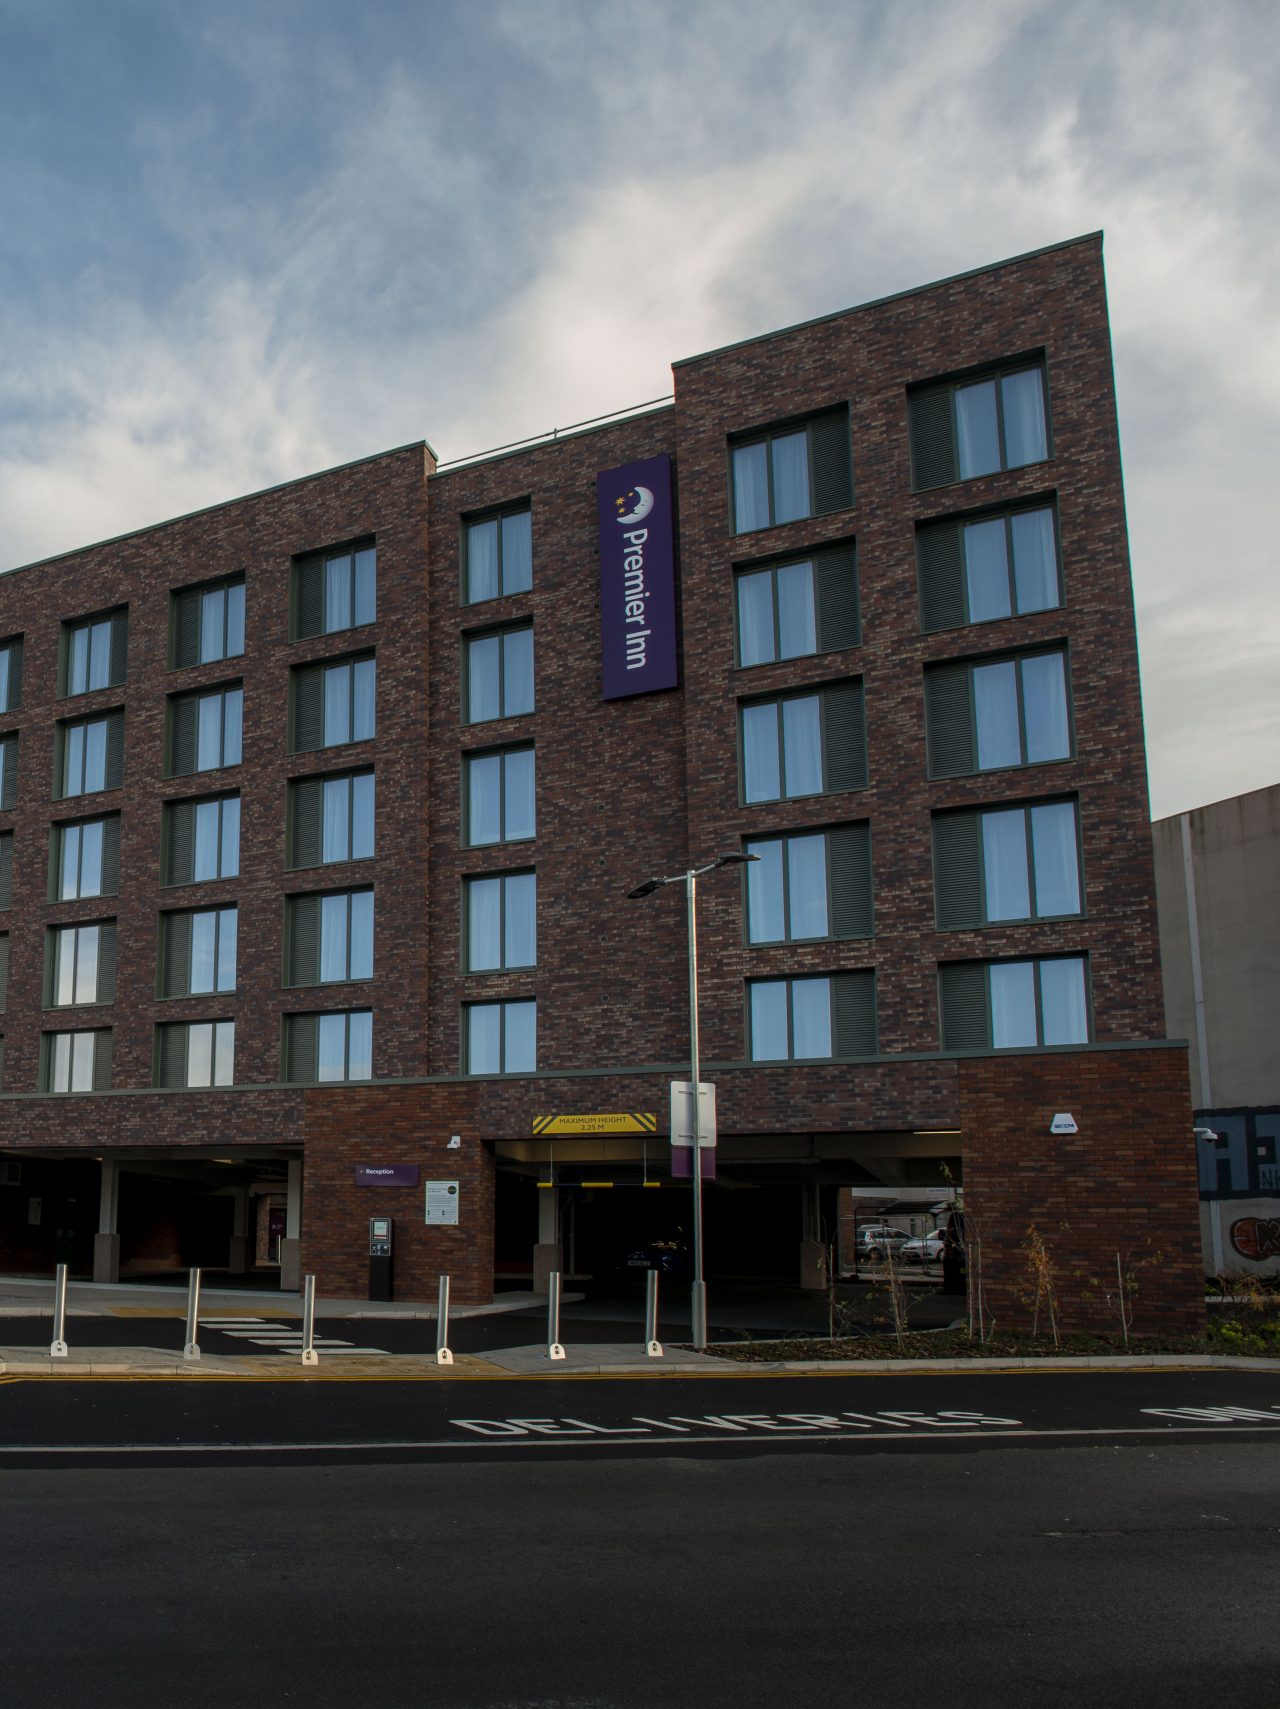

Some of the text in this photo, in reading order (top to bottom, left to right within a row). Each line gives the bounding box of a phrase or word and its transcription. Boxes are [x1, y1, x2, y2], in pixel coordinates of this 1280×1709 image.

[623, 528, 652, 670] Premier Inn
[559, 1116, 627, 1125] MAXIMUM HEIGHT
[448, 1411, 1024, 1435] DELIVERIES
